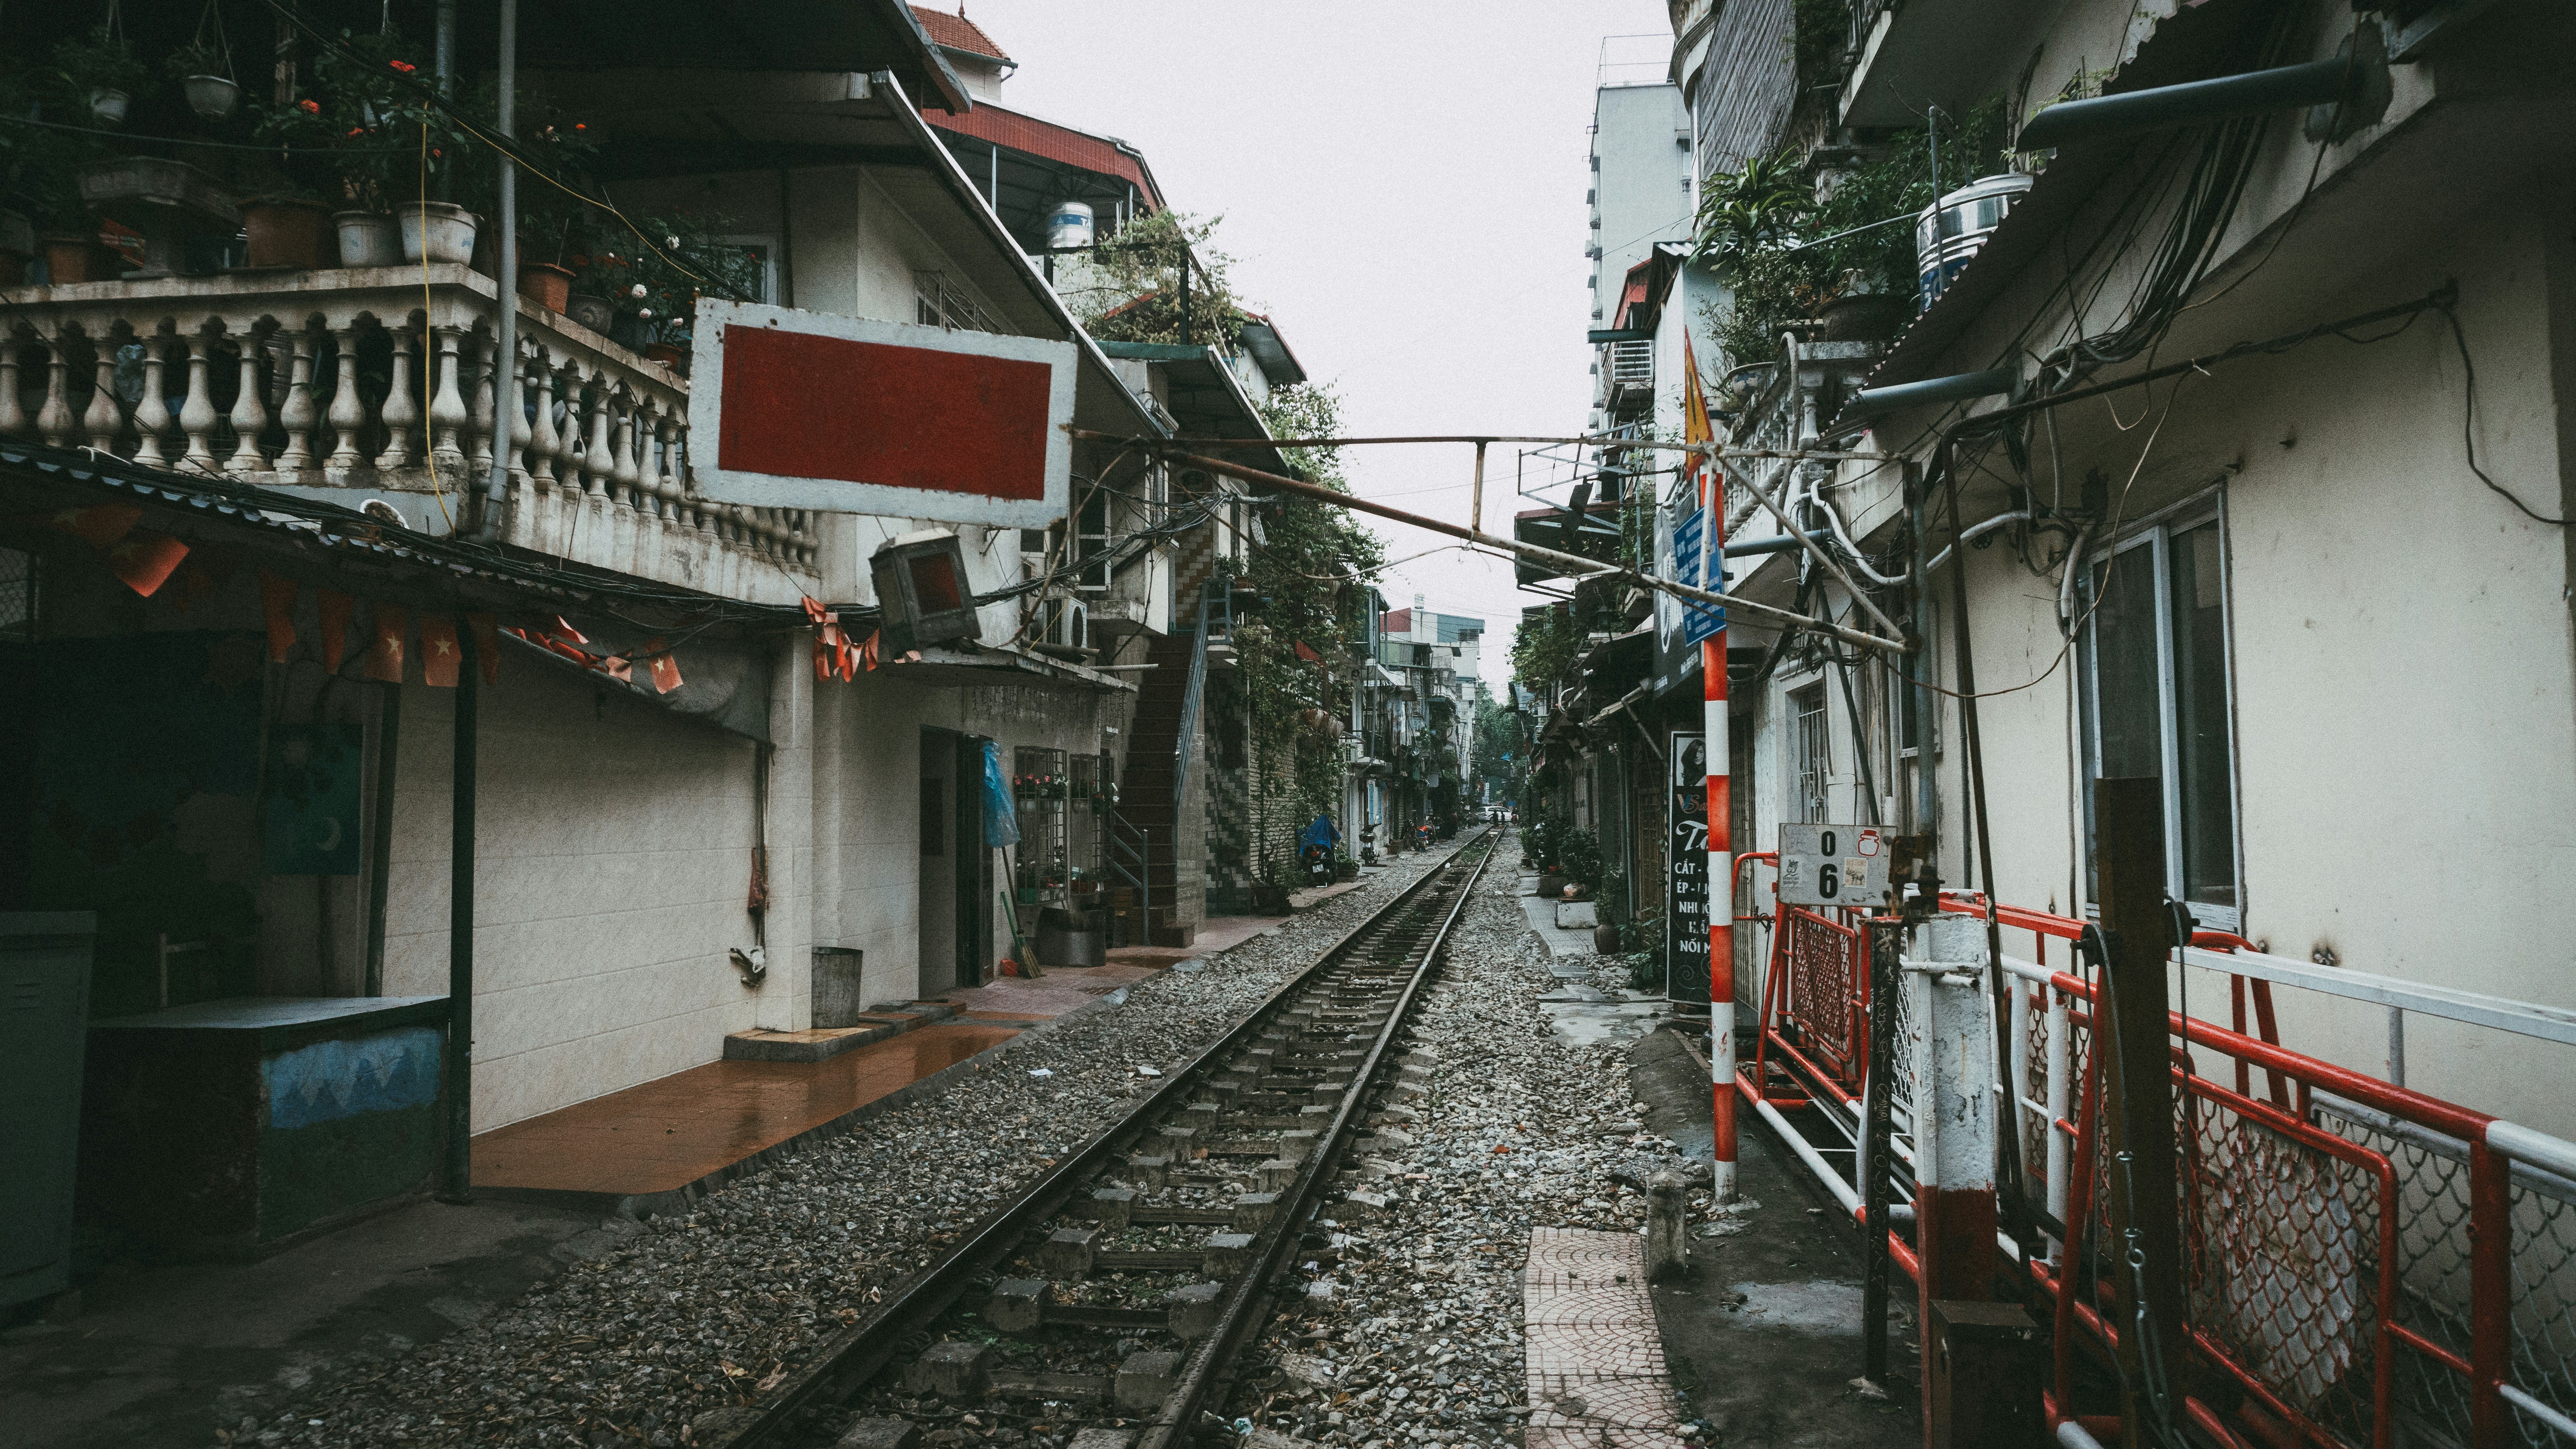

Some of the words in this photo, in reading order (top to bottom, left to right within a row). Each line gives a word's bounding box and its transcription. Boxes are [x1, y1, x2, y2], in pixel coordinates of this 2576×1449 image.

[1821, 831, 1836, 857] 0
[1674, 858, 1695, 874] CẮT
[1677, 879, 1689, 894] ÉP
[1819, 864, 1838, 899] 6
[1680, 938, 1701, 953] NỐI
